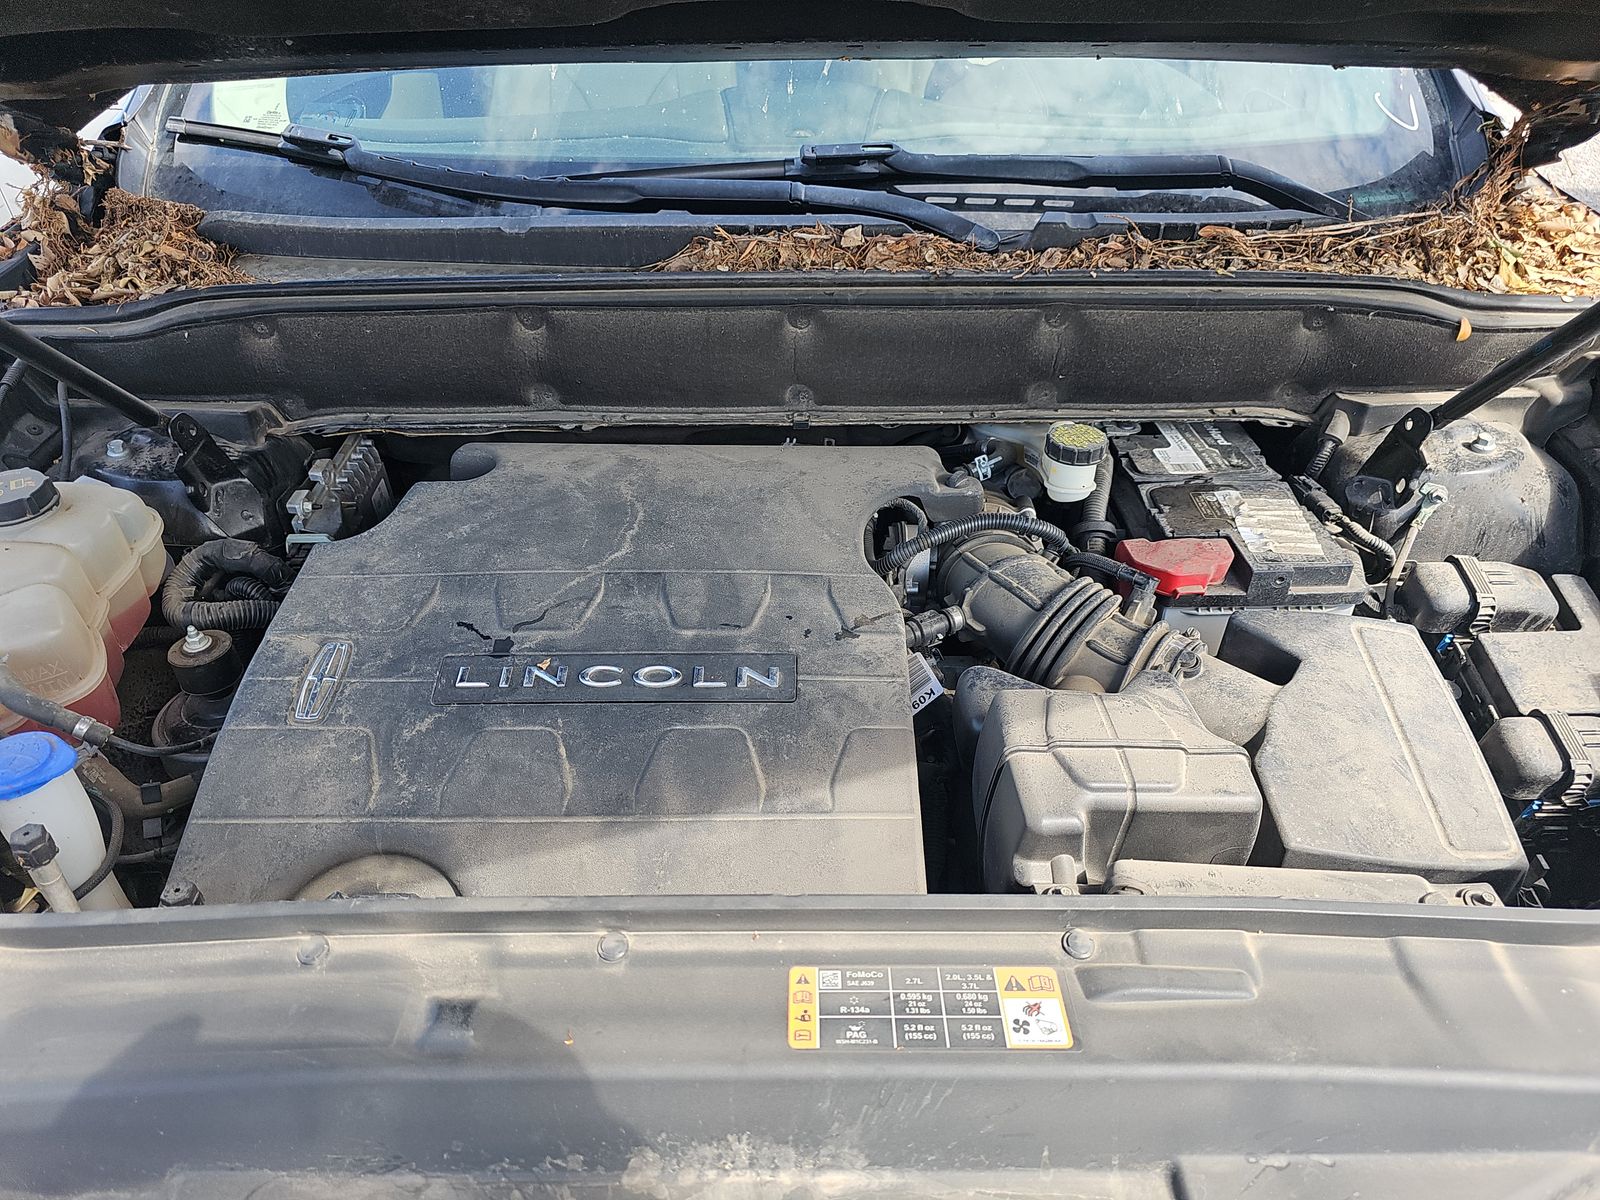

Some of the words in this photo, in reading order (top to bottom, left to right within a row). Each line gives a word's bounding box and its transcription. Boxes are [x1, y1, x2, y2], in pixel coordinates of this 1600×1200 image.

[455, 665, 780, 688] LINCOLN
[911, 687, 936, 710] K09
[846, 970, 884, 978] FoMoCo
[922, 993, 933, 1001] kg
[977, 993, 989, 1001] kg
[840, 1006, 870, 1014] R-134a
[846, 1031, 867, 1039] PAG
[904, 1032, 923, 1040] (155
[923, 1032, 937, 1040] cc)
[962, 1032, 981, 1040] (155
[981, 1032, 995, 1040] cc)
